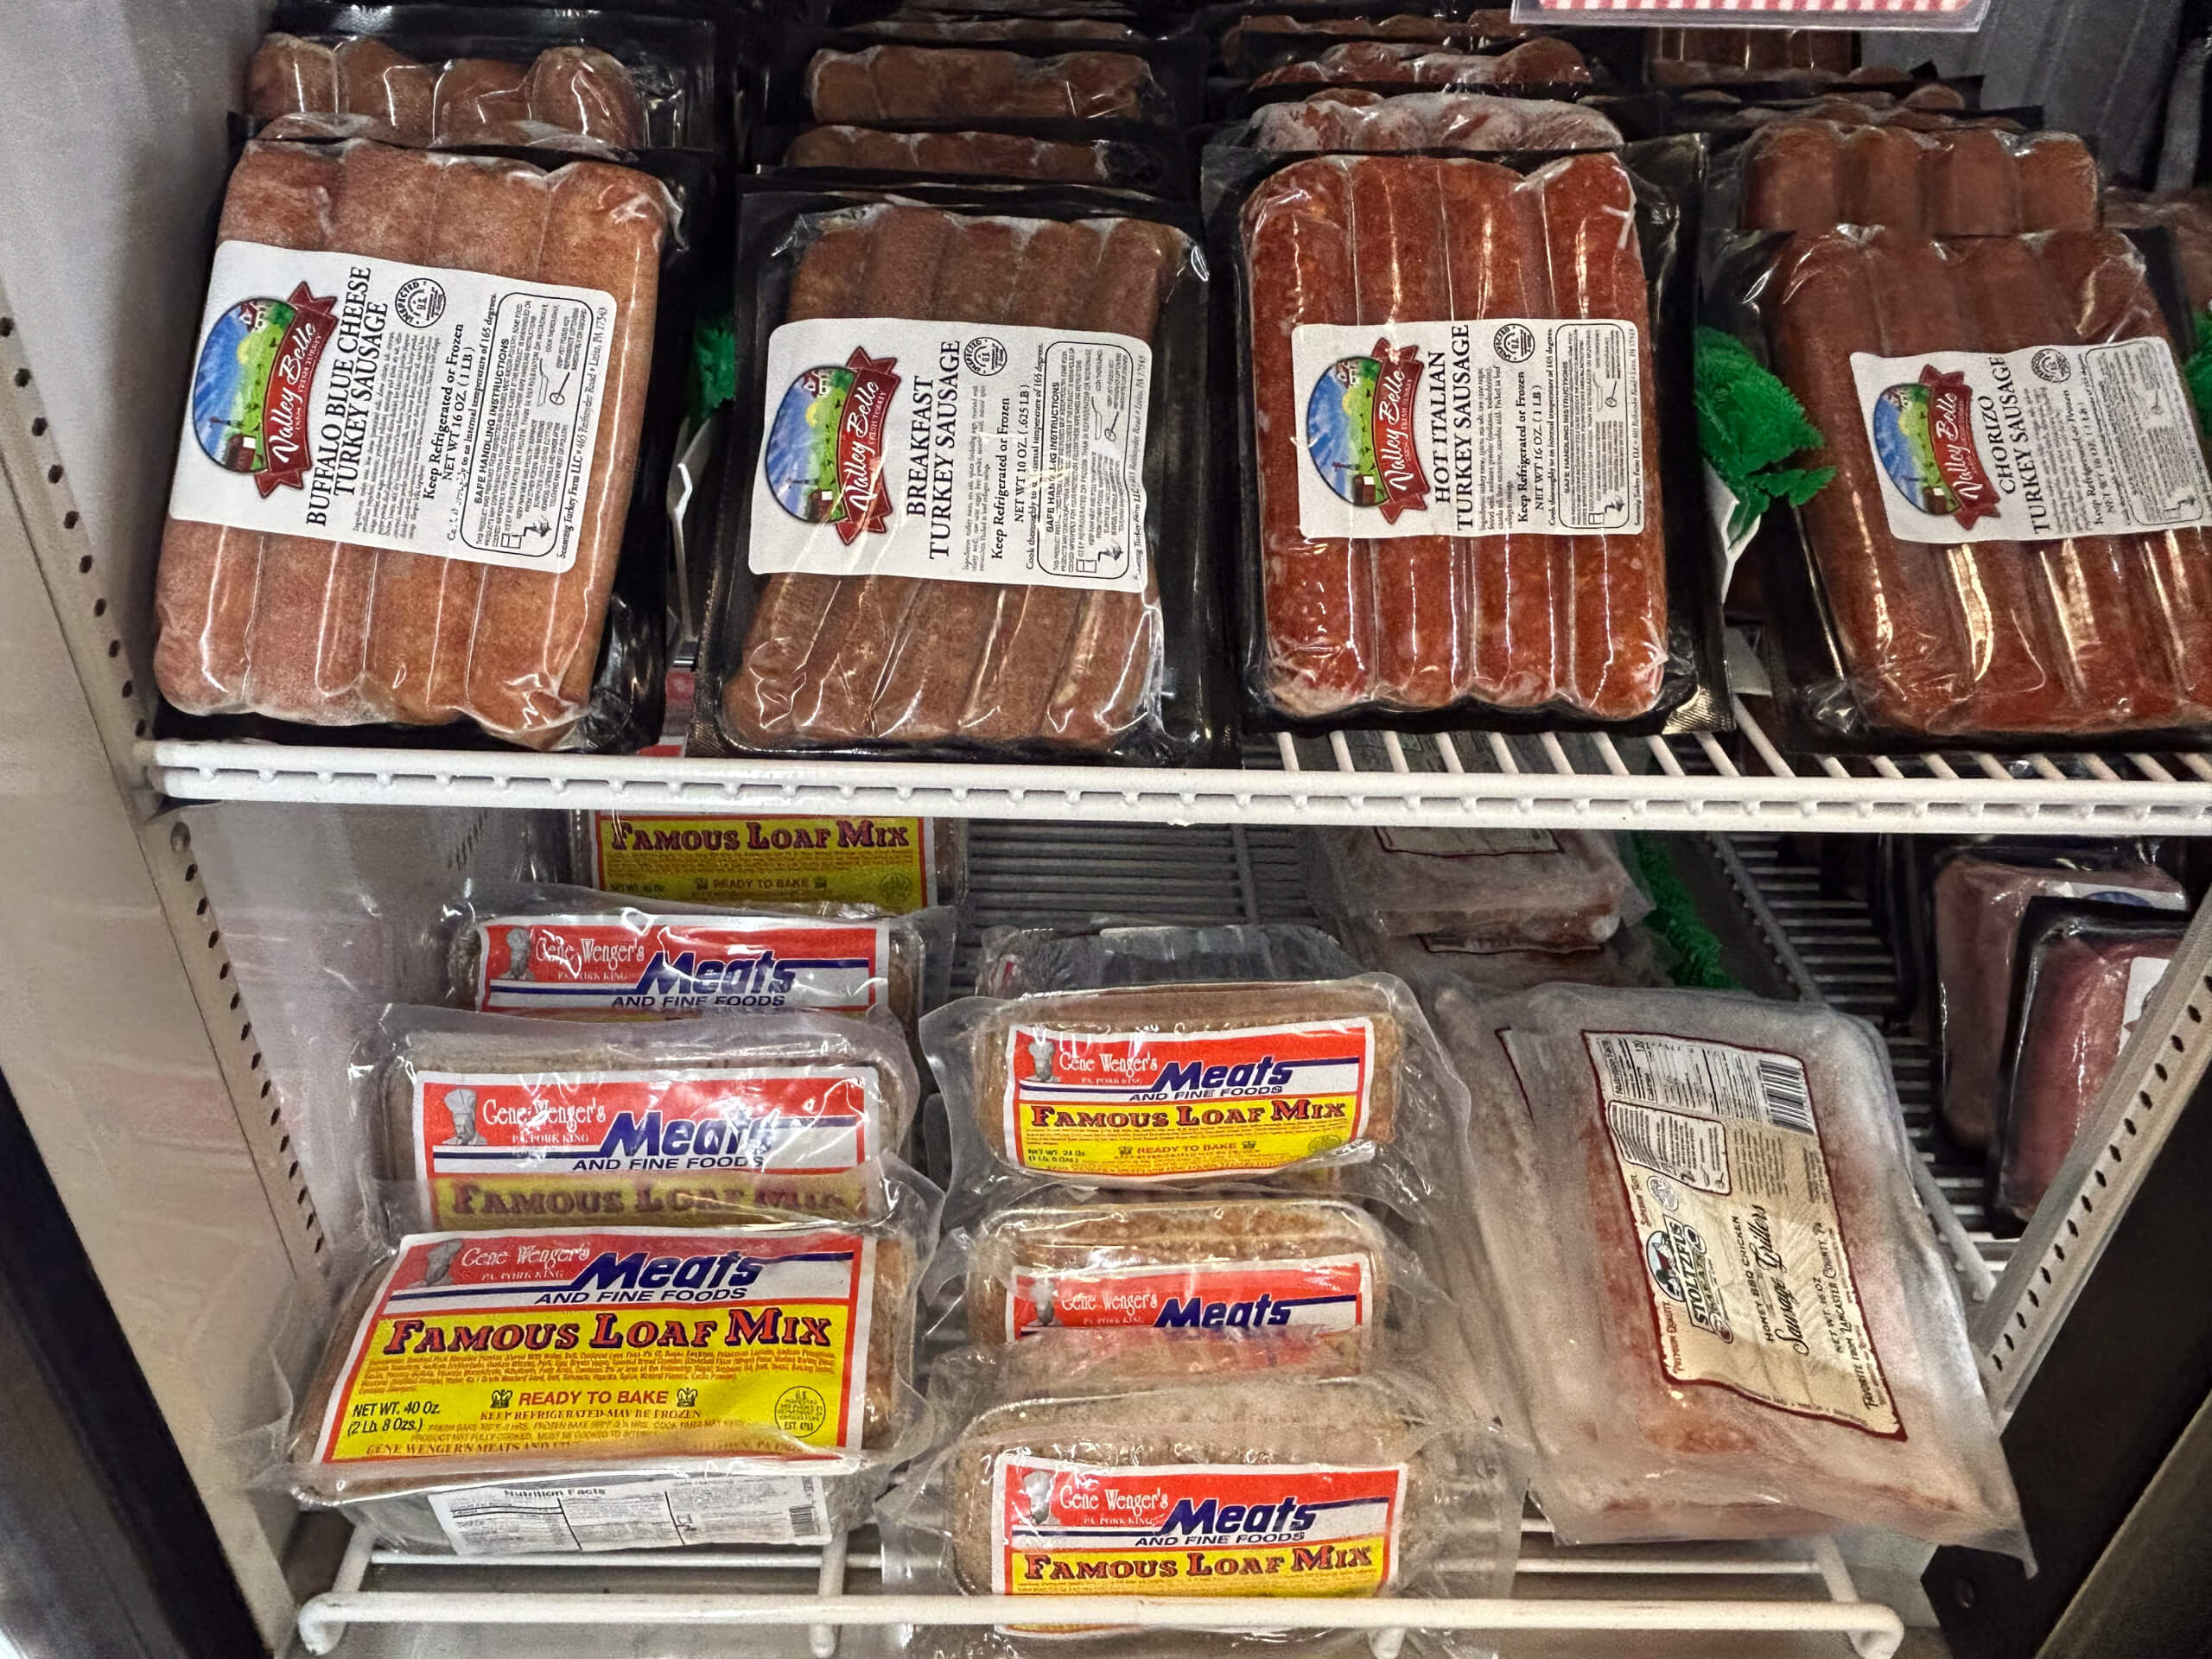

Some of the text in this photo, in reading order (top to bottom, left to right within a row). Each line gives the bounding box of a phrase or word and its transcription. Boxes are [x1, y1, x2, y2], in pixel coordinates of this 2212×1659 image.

[480, 327, 491, 342] 165
[269, 322, 315, 463] Valley Belle
[305, 266, 371, 527] BUFFALO BLUE CHEESE
[334, 302, 388, 496] TURKEY SAUSAGE
[1516, 371, 1526, 407] Frozen
[423, 323, 464, 499] Keep Refrigerated or Frozen
[451, 414, 462, 427] 16
[474, 338, 509, 504] SAFE HANDLING INSTRUCTIONS
[1049, 381, 1060, 450] INSTRUCTIONS
[1427, 351, 1451, 504] HOT ITALIAN
[1452, 324, 1473, 531] TURKEY SAUSAGE
[447, 430, 461, 451] WT
[842, 381, 880, 512] Valley Belle
[906, 375, 933, 518] BREAKFAST
[1379, 370, 1414, 491] Valley Belle
[1977, 395, 2016, 494] CHORIZO
[1989, 358, 2050, 534] TURKEY SAUSAGE
[442, 453, 455, 480] NET
[570, 455, 583, 474] LLC
[929, 340, 960, 560] TURKEY SAUSAGE
[1516, 425, 1531, 492] Refrigerated
[991, 397, 1009, 559] Keep Refrigerated or Frozen
[1015, 475, 1026, 494] WT
[1534, 462, 1543, 484] WT
[1014, 499, 1025, 523] NET
[1517, 493, 1531, 522] Keep
[611, 820, 910, 851] FAMOUS LOAF MIX
[581, 938, 645, 970] Wenger's
[635, 950, 797, 995] Meats
[612, 995, 785, 1007] AND FINE FOODS
[1059, 1052, 1158, 1078] Gene Wenger's
[1150, 1056, 1294, 1093] Meats
[1129, 1085, 1282, 1102] AND FINE FOODS
[483, 1099, 524, 1125] Gene
[1031, 1099, 1346, 1128] FAMOUS LOAF MIX
[572, 1156, 765, 1171] AND FINE FOODS
[452, 1179, 625, 1216] FAMOUS
[1747, 1205, 1788, 1274] Grillers
[461, 1243, 590, 1273] Gene Wenger's
[570, 1250, 764, 1291] Meats
[1669, 1221, 1709, 1326] STOLTZFUS
[534, 1287, 748, 1305] AND FINE FOODS
[1732, 1216, 1775, 1341] HONEY BBQ CHICKEN
[1102, 1292, 1158, 1316] Wenger's
[1154, 1294, 1293, 1327] Meats
[1770, 1277, 1809, 1356] Sausage
[1827, 1282, 1852, 1333] LANCASTER
[383, 1307, 831, 1355] FAMOUS LOAF MIX
[518, 1390, 669, 1406] READY TO BAKE
[1853, 1357, 1878, 1410] FAVORITE
[353, 1402, 420, 1417] NET WT. 40
[480, 1410, 512, 1421] KEEP
[653, 1409, 702, 1419] FROZEN
[347, 1421, 361, 1438] (2
[382, 1420, 390, 1433] 8
[366, 1444, 403, 1455] GENE
[504, 1487, 607, 1499] Nutrition Facts
[1059, 1485, 1168, 1516] Gene Wenger's
[1159, 1497, 1317, 1536] Meats
[1135, 1531, 1305, 1546] AND FINE FOODS
[1025, 1545, 1372, 1580] FAMOUS LOAF MIX
